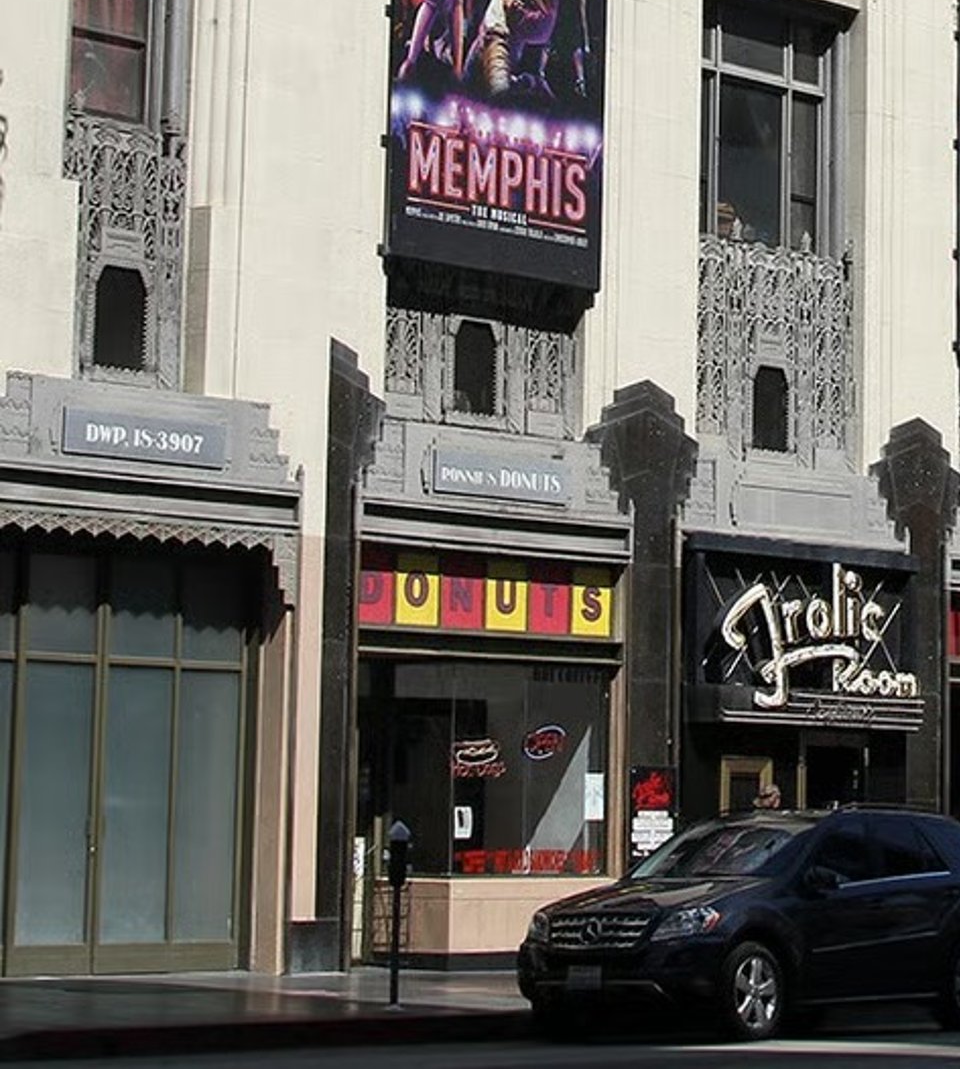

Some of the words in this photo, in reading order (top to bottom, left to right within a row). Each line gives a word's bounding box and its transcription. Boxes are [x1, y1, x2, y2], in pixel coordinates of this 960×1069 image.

[408, 130, 587, 224] MEMPHIS
[471, 204, 489, 218] THE
[490, 207, 528, 226] MUSICAL
[85, 422, 130, 448] DWP.
[500, 468, 562, 493] DONUTS
[360, 569, 603, 623] DONUTS
[721, 562, 887, 710] Frolic
[831, 657, 920, 699] Room
